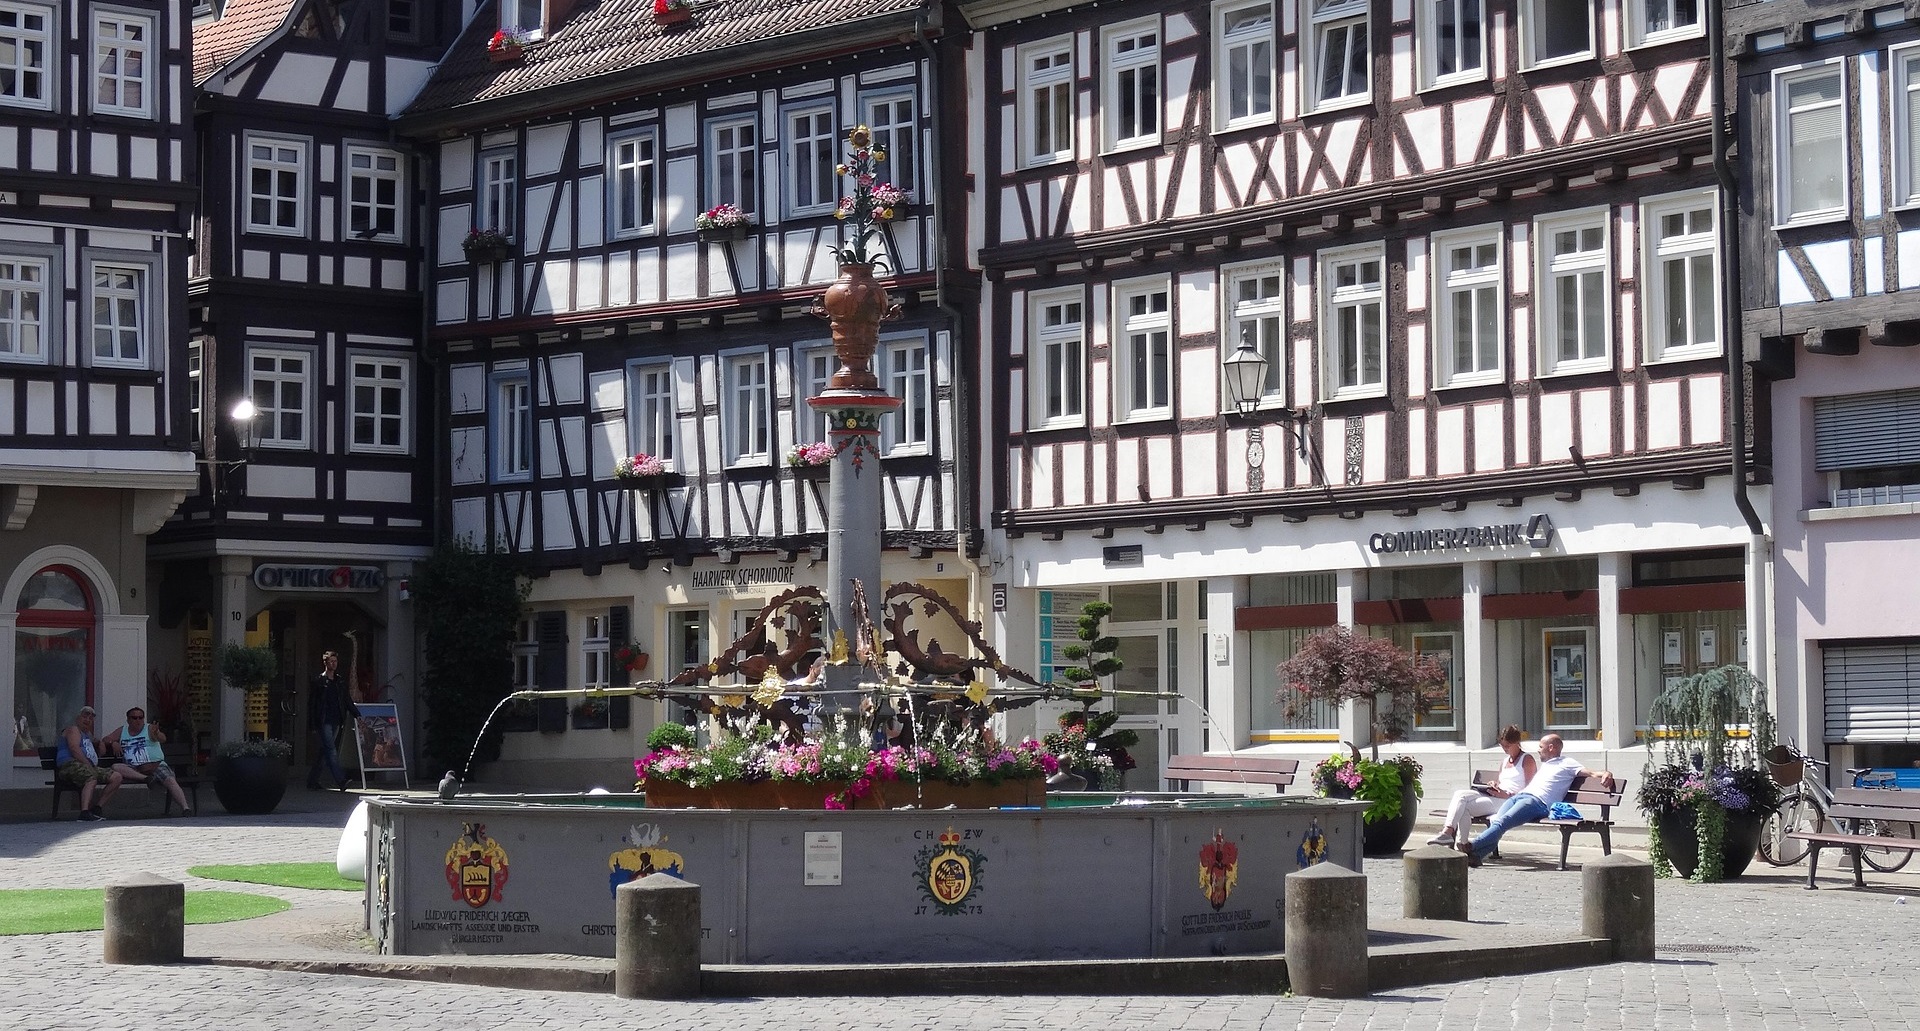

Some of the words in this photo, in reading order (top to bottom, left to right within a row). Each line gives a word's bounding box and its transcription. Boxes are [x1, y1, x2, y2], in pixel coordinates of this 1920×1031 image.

[1369, 524, 1522, 554] COMMERZBANK
[692, 569, 736, 588] HAARWERK
[738, 566, 795, 585] SCHORNDORF
[130, 588, 137, 598] 9
[993, 592, 1006, 608] 6
[231, 611, 242, 621] 10
[424, 909, 457, 921] LUDWIG
[458, 910, 499, 922] FRIDERICH
[497, 924, 512, 933] UND
[513, 924, 541, 933] ERSTER
